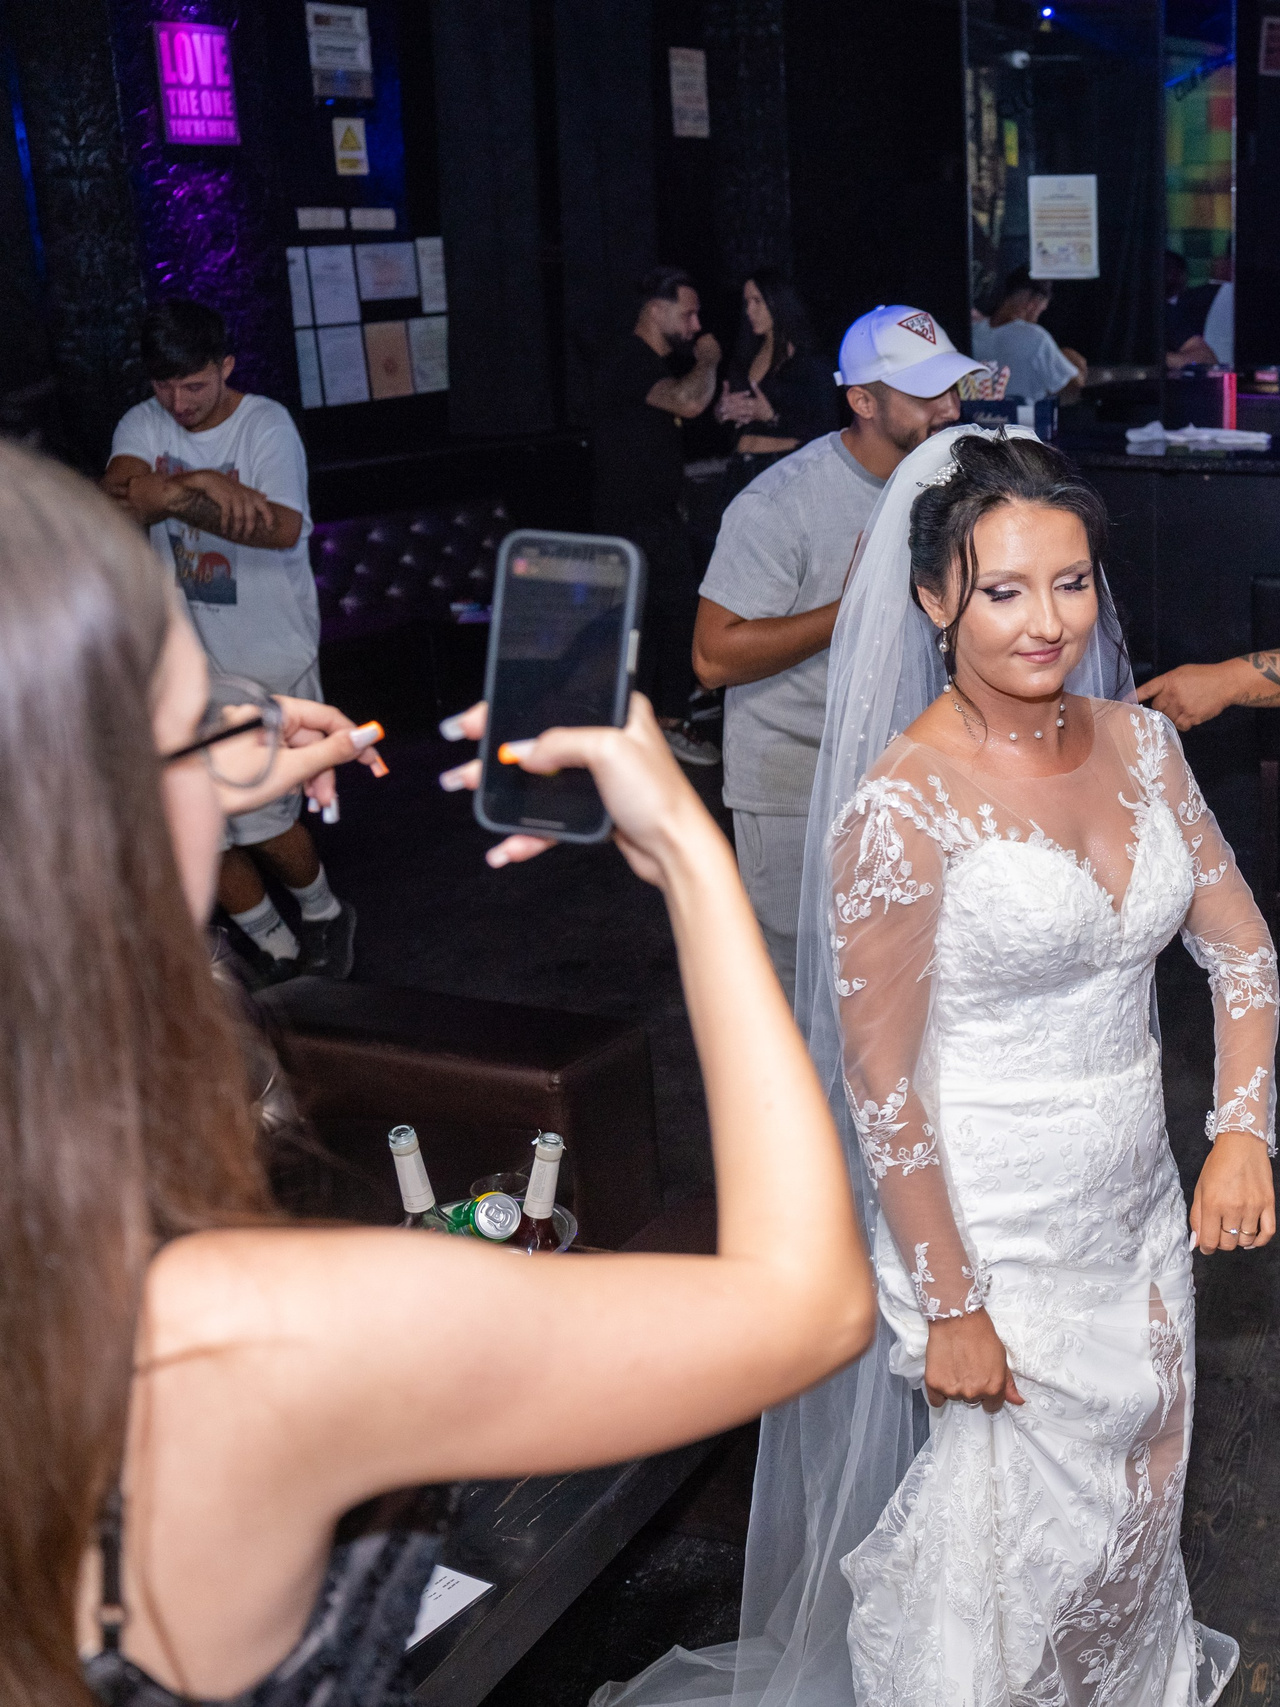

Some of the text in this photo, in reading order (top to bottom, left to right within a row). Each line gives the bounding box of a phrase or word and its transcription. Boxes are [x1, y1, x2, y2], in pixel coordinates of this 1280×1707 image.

[159, 31, 231, 86] LOVE
[166, 89, 234, 117] THE ONE
